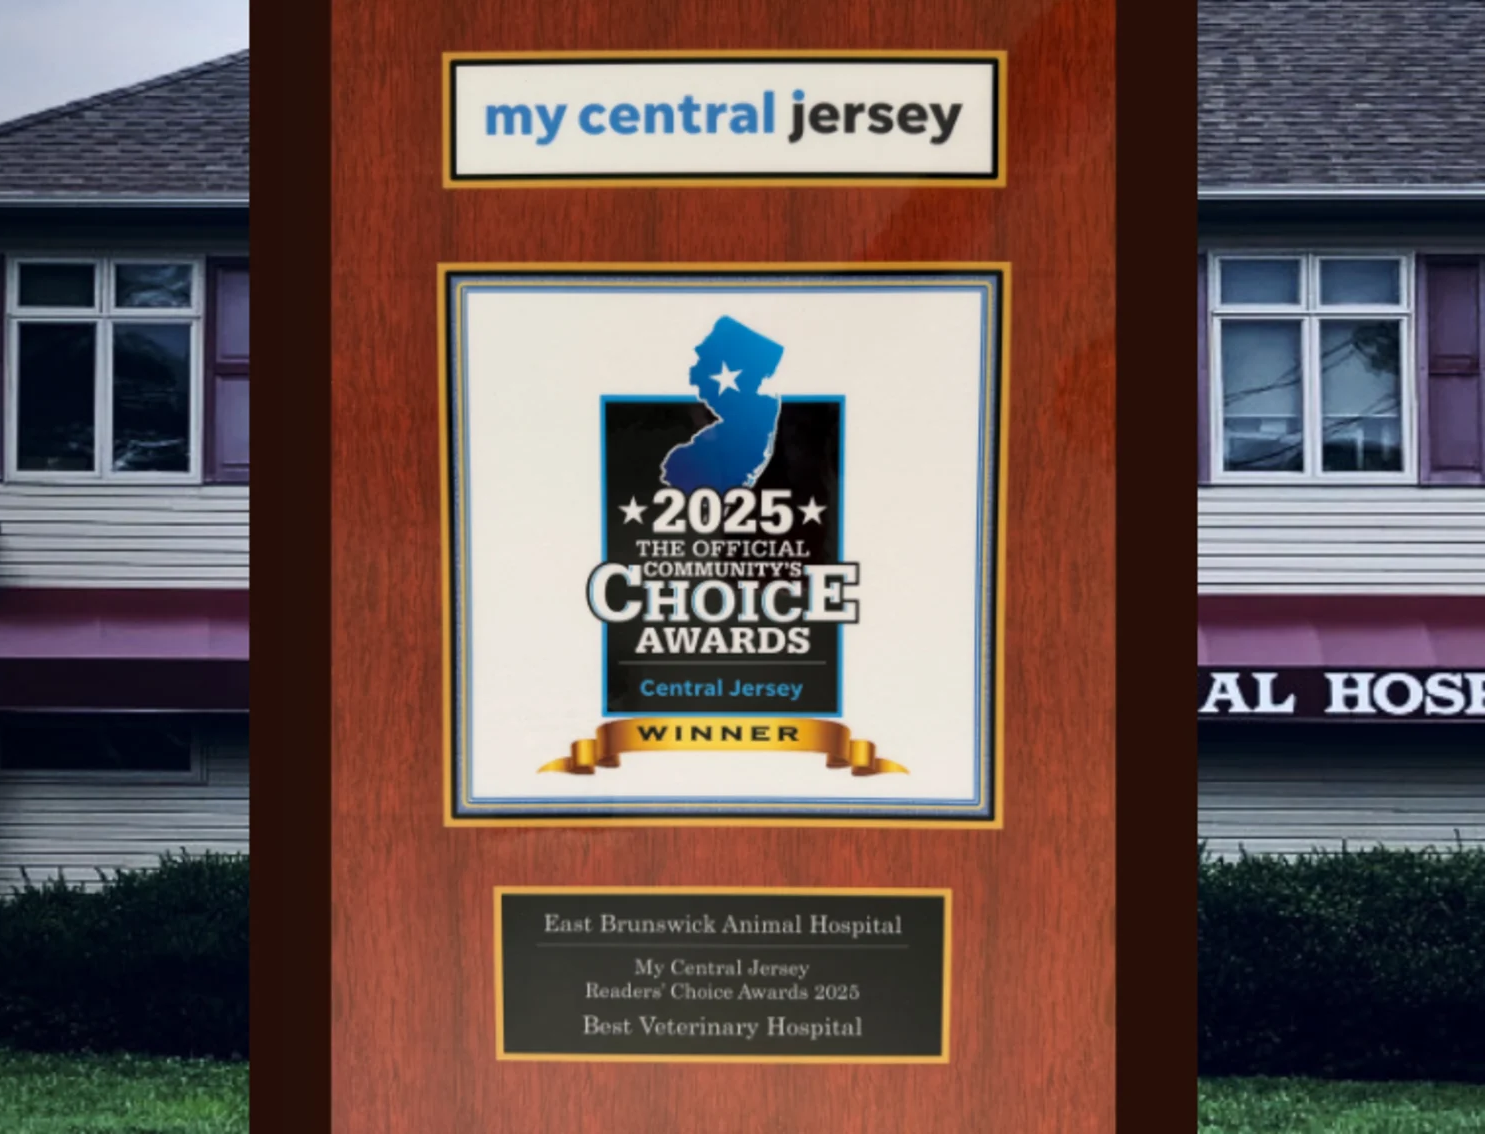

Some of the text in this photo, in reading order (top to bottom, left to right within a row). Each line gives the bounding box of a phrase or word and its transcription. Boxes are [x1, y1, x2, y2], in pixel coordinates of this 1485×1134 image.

[485, 89, 964, 146] my central jersey
[652, 488, 794, 534] 2025
[636, 540, 811, 558] THE OFFICIAL
[643, 561, 802, 578] COMMUNITY'S
[587, 561, 860, 624] CHOICE
[635, 627, 811, 654] AWARDS
[640, 678, 804, 701] Central Jersey
[1197, 672, 1297, 714] AL
[637, 725, 801, 742] WINNER
[544, 914, 902, 939] East Brunswick Animal Hospital
[634, 959, 810, 980] My Central Jersey
[585, 982, 860, 1001] Readers' Choice Awards 2025
[583, 1015, 863, 1041] Best Veterinary Hospital
